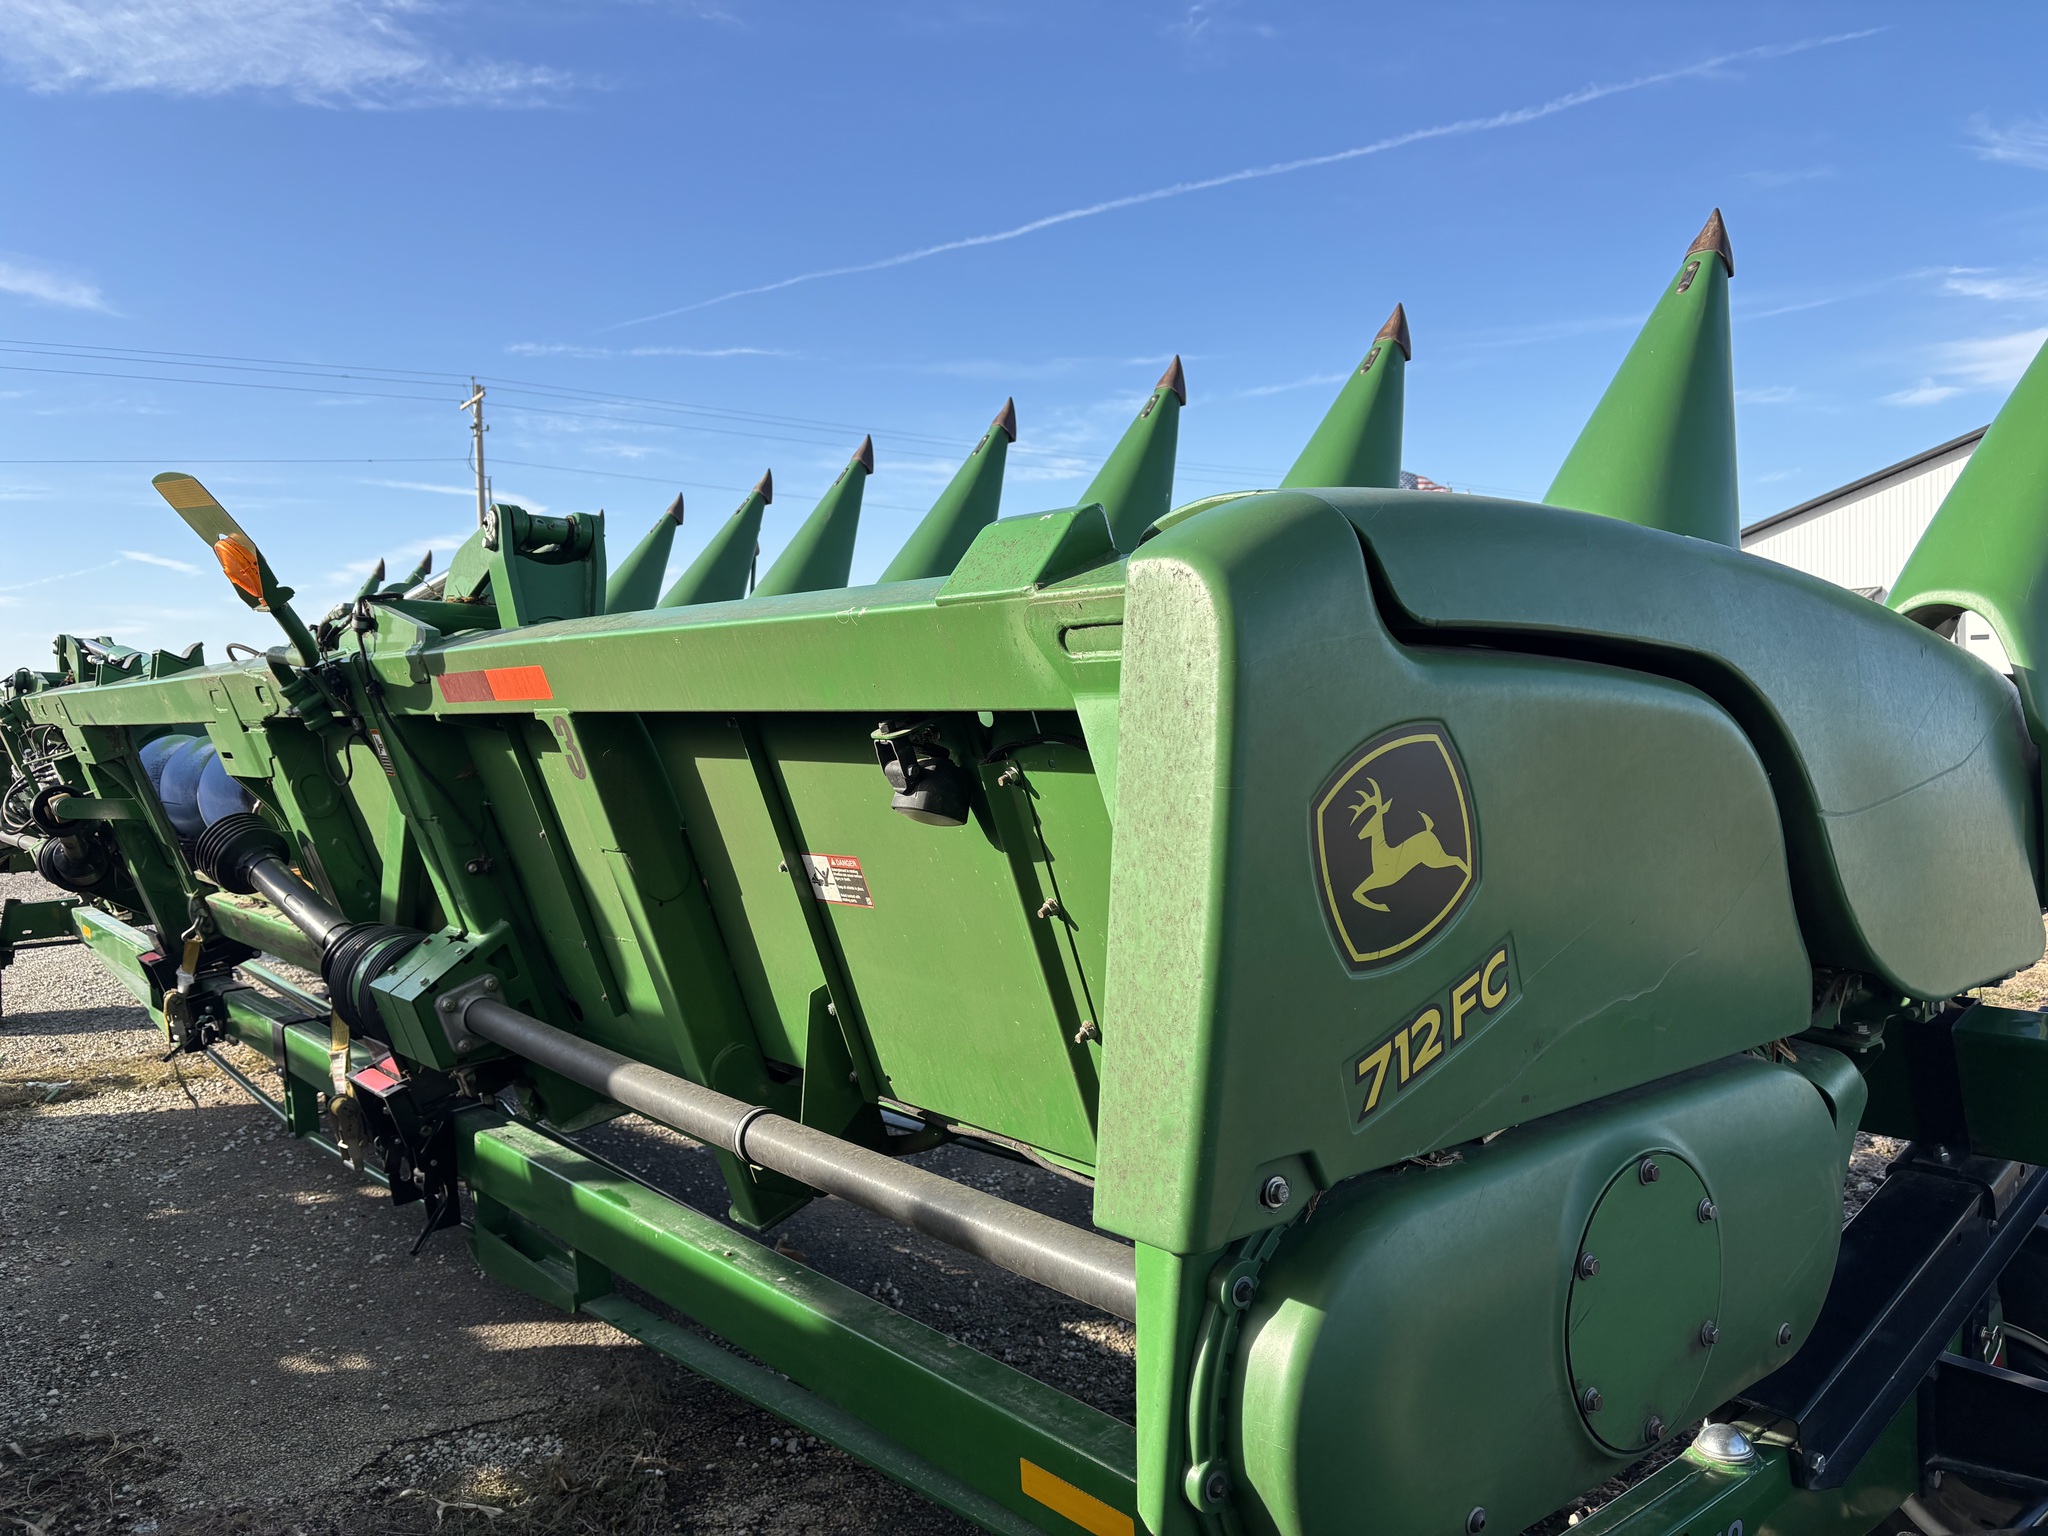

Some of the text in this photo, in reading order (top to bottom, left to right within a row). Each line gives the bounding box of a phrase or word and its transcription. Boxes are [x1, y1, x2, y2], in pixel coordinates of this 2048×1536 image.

[552, 715, 587, 780] 3
[836, 859, 858, 868] DANGER
[1356, 947, 1508, 1116] 712 FC
